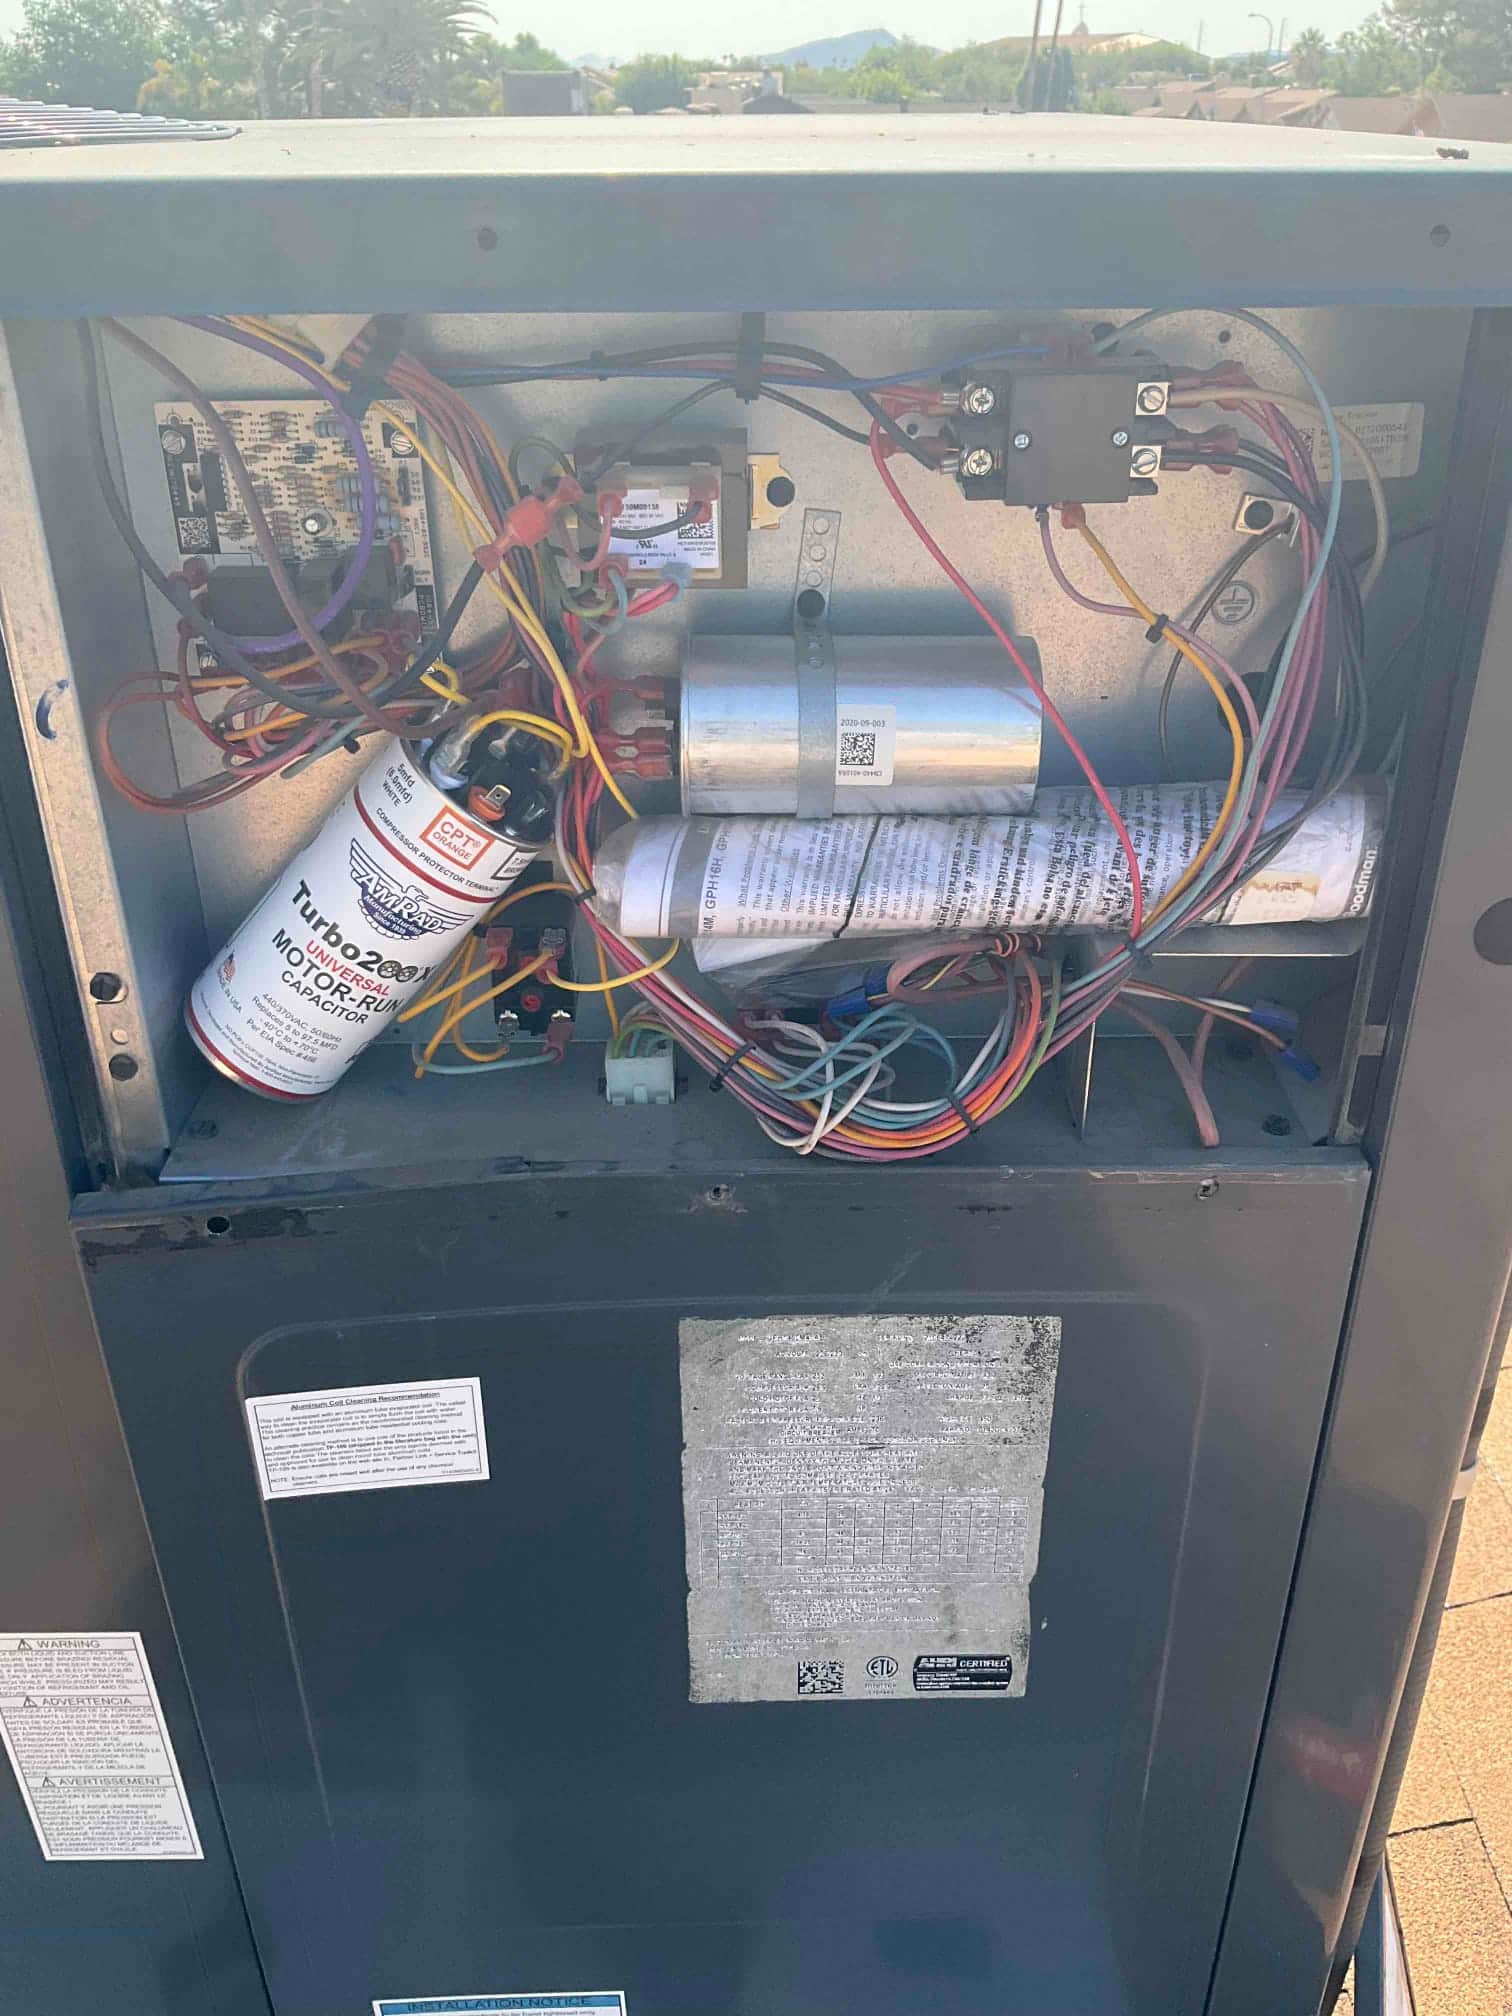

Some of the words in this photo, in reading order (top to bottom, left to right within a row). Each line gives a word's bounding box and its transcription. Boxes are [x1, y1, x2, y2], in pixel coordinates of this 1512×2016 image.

[382, 782, 402, 807] WHITE
[376, 807, 419, 854] COMPRESSOR
[418, 852, 466, 884] PROTECTOR
[432, 832, 472, 860] ORANGE
[1064, 841, 1078, 878] peligro
[964, 881, 974, 894] de
[1061, 881, 1072, 894] de
[272, 929, 403, 1013] MOTOR-RUN
[306, 940, 391, 997] UNIVERSAL
[282, 971, 369, 1025] CAPACITOR
[291, 1402, 328, 1411] Aluminum
[329, 1400, 344, 1408] Coil
[37, 1640, 100, 1649] WARNING
[959, 1660, 1008, 1668] CERTIFIED
[42, 1697, 132, 1706] ADVERTENCIA
[59, 1777, 161, 1786] AVERTISSEMENT
[407, 1999, 523, 2013] INSTALLATION
[528, 1998, 592, 2008] NOTICE
